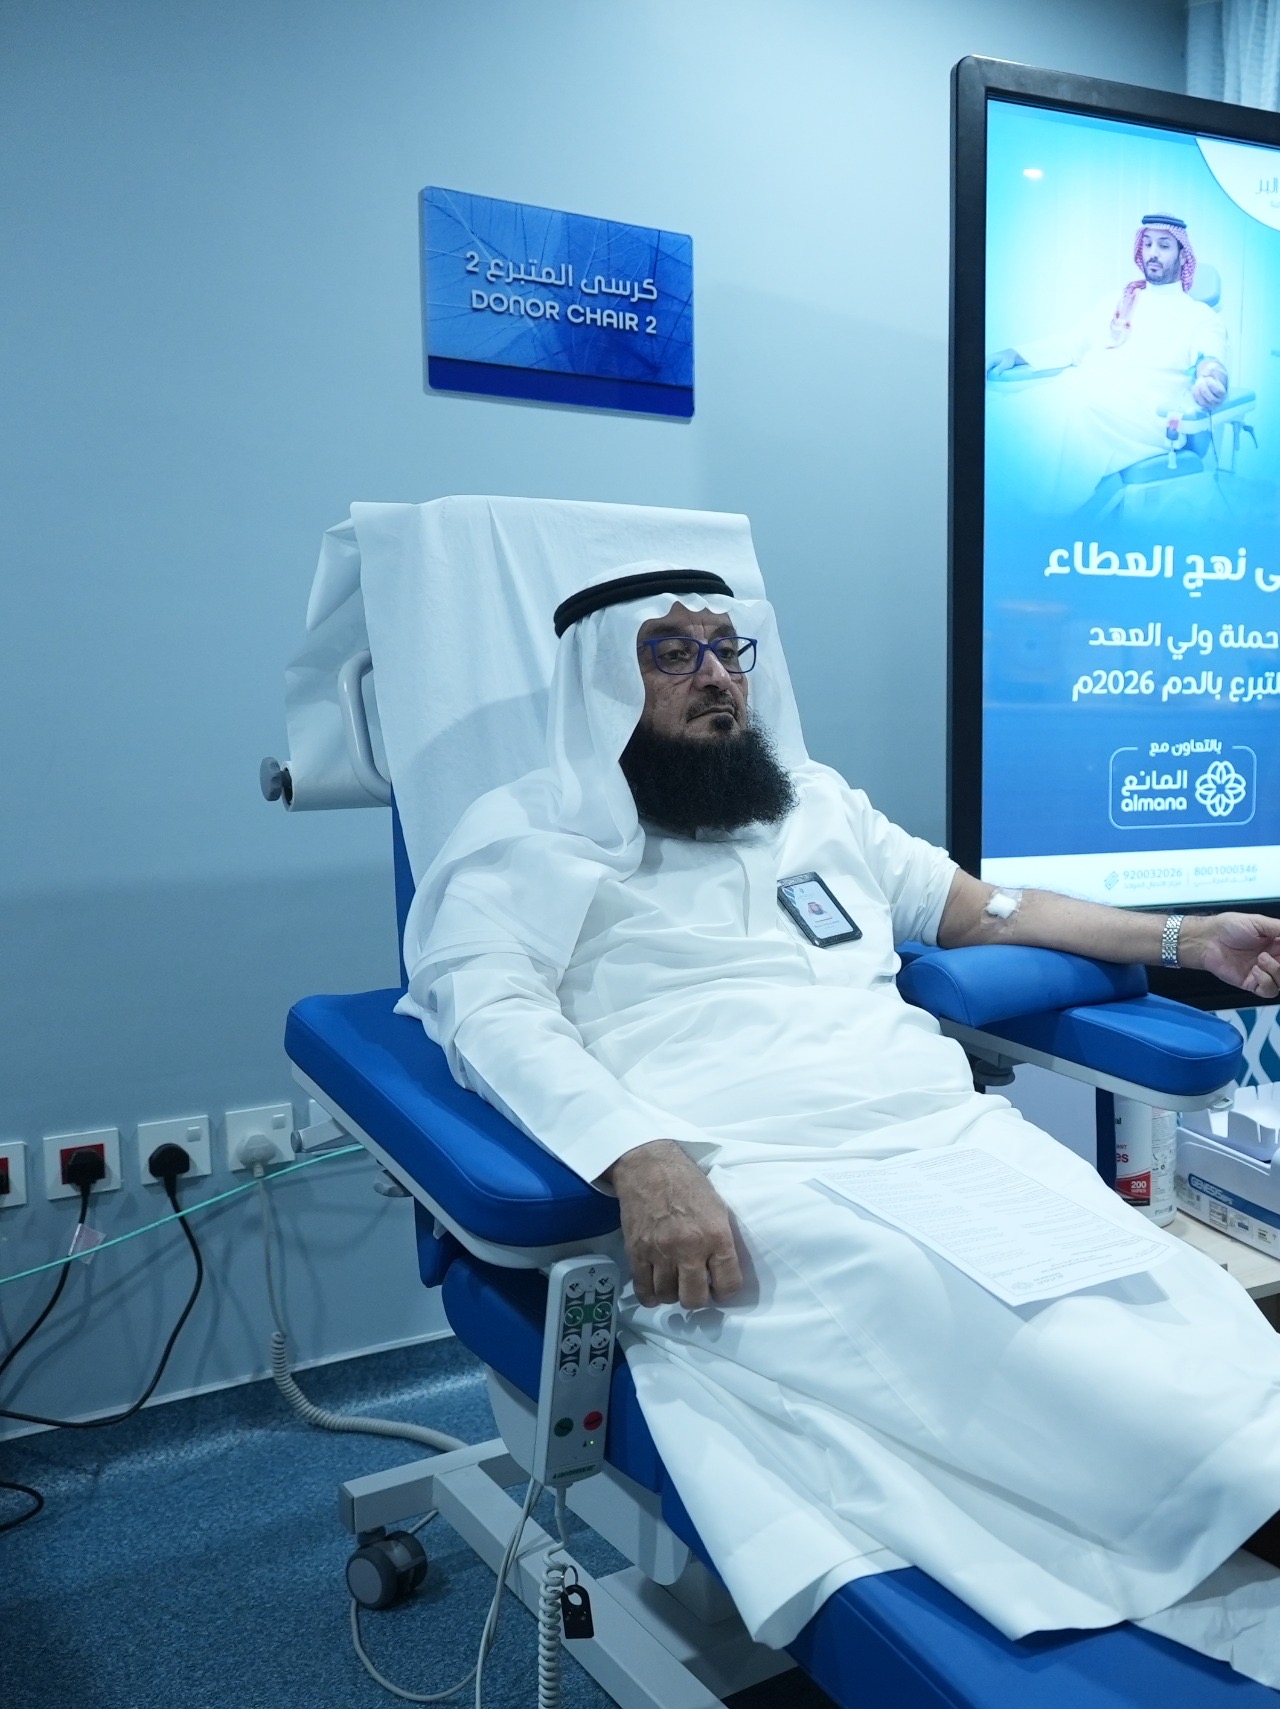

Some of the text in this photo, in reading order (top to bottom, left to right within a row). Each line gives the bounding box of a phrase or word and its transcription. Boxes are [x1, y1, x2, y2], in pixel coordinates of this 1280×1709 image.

[465, 251, 480, 273] 2
[486, 257, 573, 288] المتبرع
[471, 289, 657, 335] DONOR CHAIR 2
[1044, 541, 1174, 578] العطاء
[1089, 622, 1279, 660] حملة ولي العهد
[1162, 671, 1223, 702] بالدم
[1149, 739, 1222, 757] بالتعاون مع
[1121, 769, 1188, 796] المانع
[1121, 794, 1188, 812] almana
[1123, 868, 1183, 880] 920032026
[1131, 1181, 1147, 1189] 200
